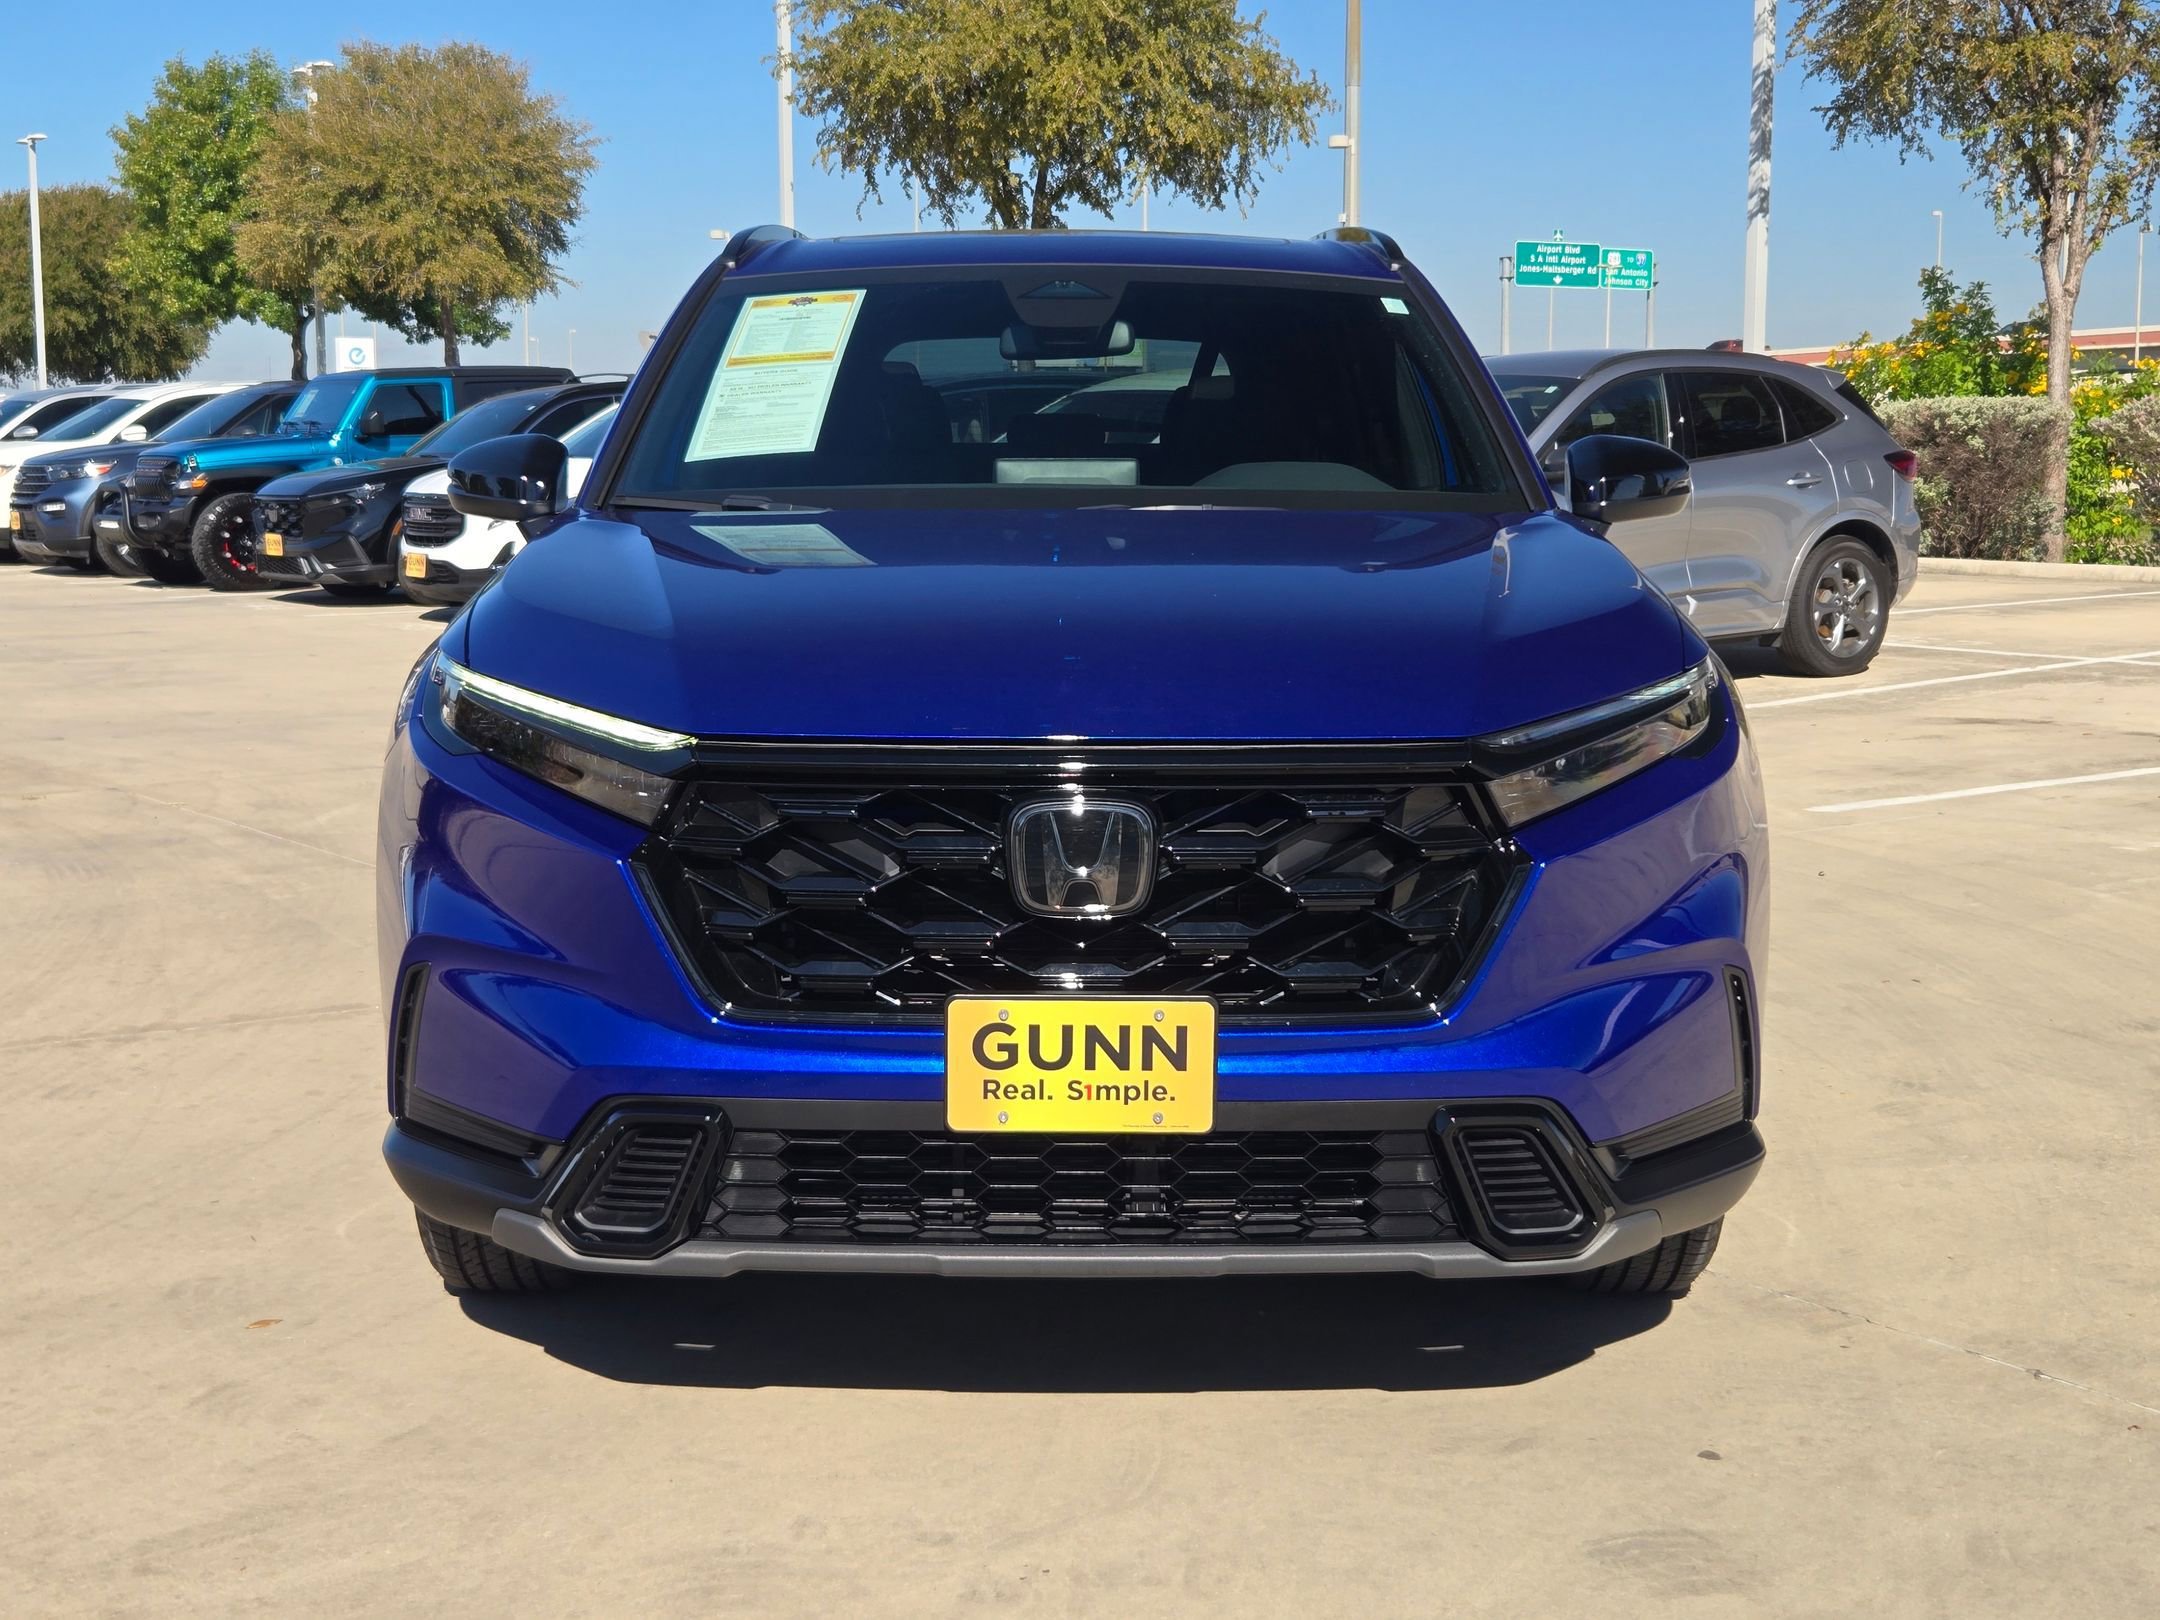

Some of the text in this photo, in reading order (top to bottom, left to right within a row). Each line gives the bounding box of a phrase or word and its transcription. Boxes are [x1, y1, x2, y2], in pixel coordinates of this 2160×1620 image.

[1537, 245, 1581, 254] Airport Blvd
[1530, 254, 1535, 262] S
[1561, 256, 1586, 265] Airport
[1621, 268, 1648, 277] Antonio
[1635, 279, 1648, 288] City
[972, 1022, 1188, 1072] GUNN
[983, 1079, 1053, 1100] Real.
